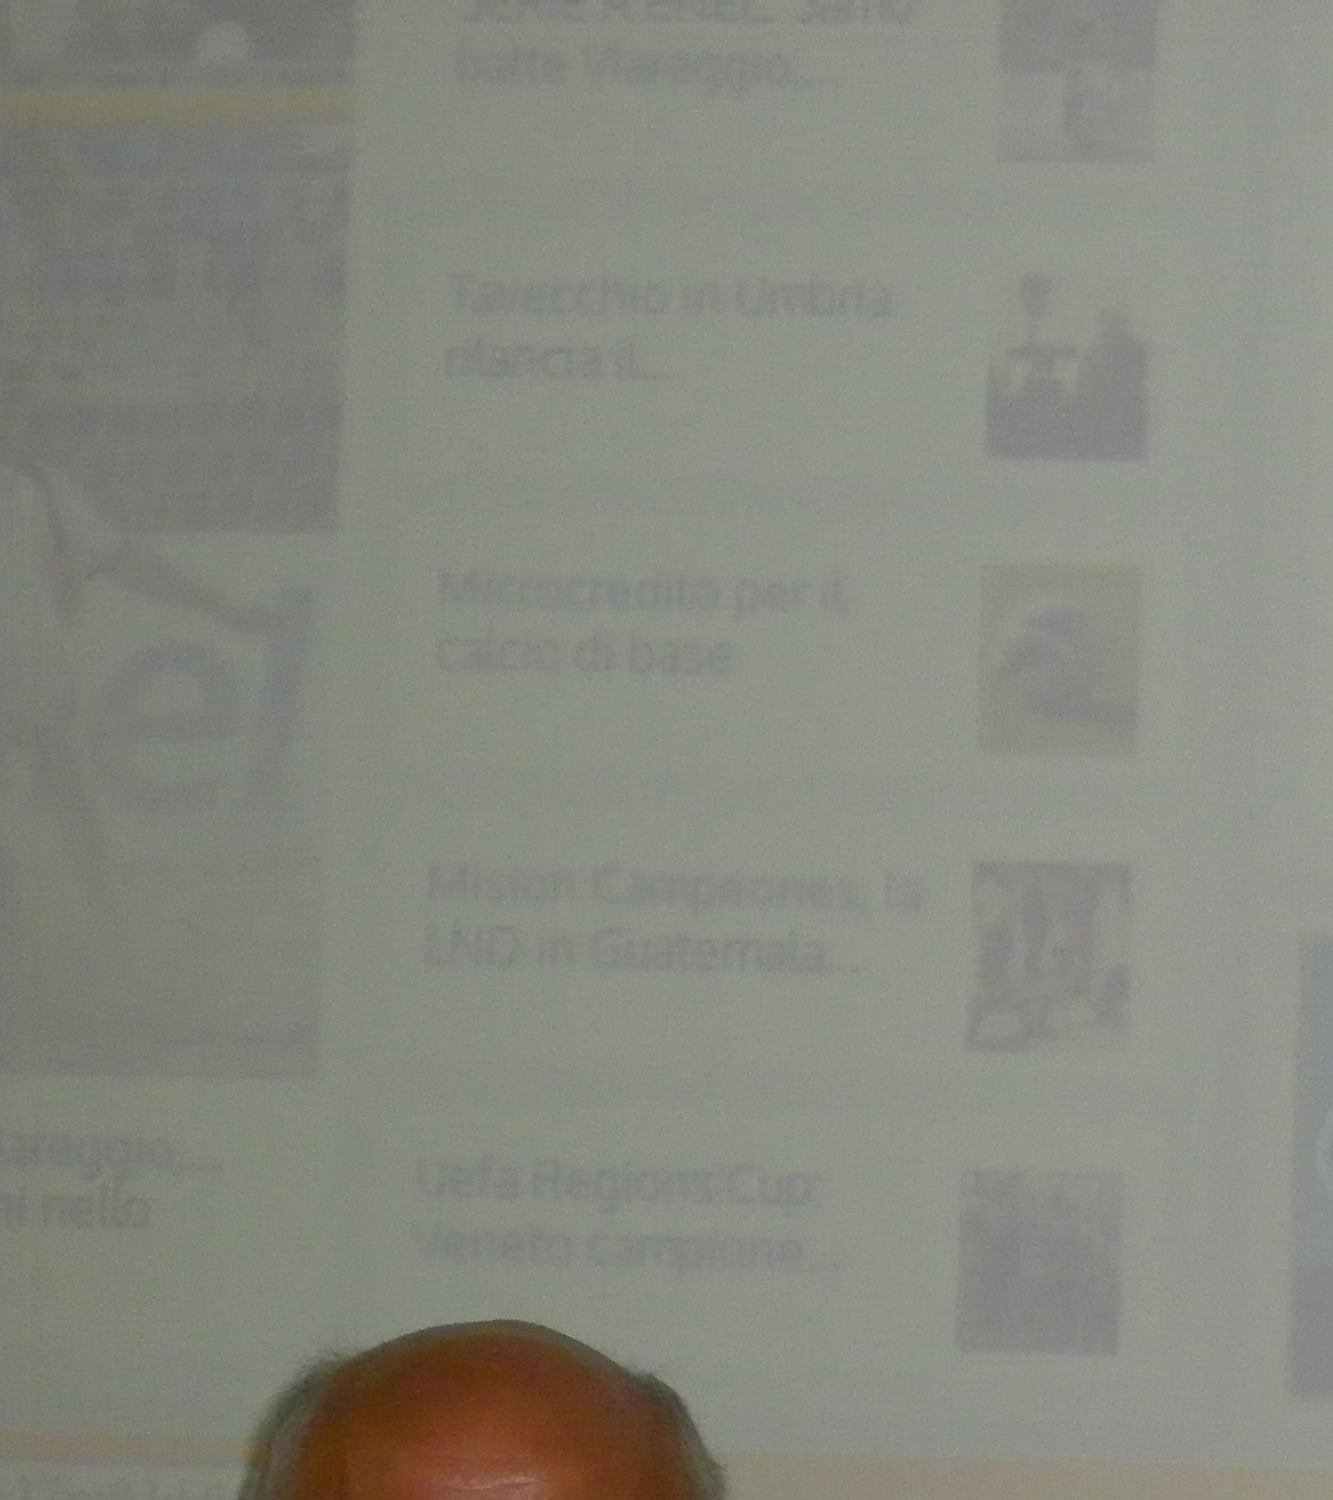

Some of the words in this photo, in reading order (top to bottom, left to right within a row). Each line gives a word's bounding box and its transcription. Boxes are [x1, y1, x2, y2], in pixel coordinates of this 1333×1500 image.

[455, 37, 570, 85] batte
[448, 272, 669, 315] Tavecchio
[679, 275, 724, 315] in
[735, 273, 896, 319] Umbria
[444, 338, 604, 381] rilancia
[436, 571, 722, 615] Microcredito
[733, 575, 819, 625] per
[823, 569, 850, 617] il
[431, 626, 560, 674] calcio
[572, 628, 617, 676] di
[627, 630, 735, 677] base
[424, 860, 577, 902] Mision
[883, 868, 926, 912] la
[423, 922, 521, 969] LND
[536, 924, 575, 971] in
[40, 1186, 151, 1230] nello
[415, 1153, 521, 1201] Uefa
[532, 1157, 714, 1215] Regions
[413, 1224, 576, 1267] Veneto
